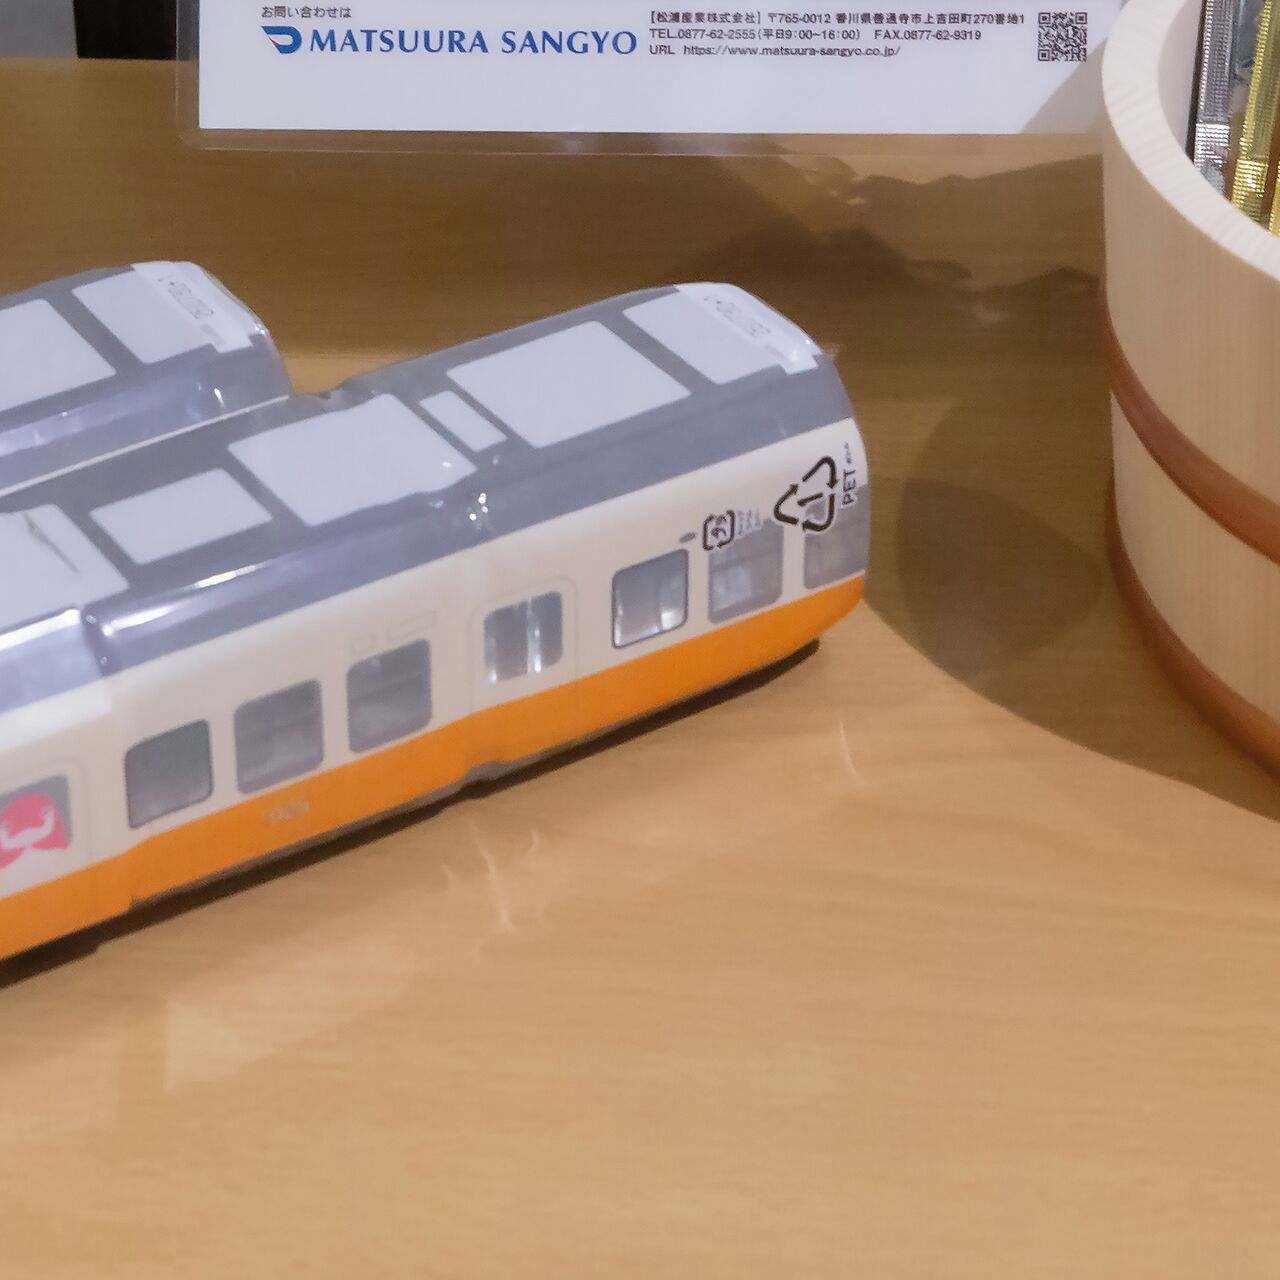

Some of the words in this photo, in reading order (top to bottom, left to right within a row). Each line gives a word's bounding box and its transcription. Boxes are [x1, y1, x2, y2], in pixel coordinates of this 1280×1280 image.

[260, 5, 352, 19] お問い合わせは
[310, 29, 489, 54] MATSUURA
[501, 29, 638, 55] SANGYO
[650, 46, 675, 56] URL
[842, 469, 857, 506] PET
